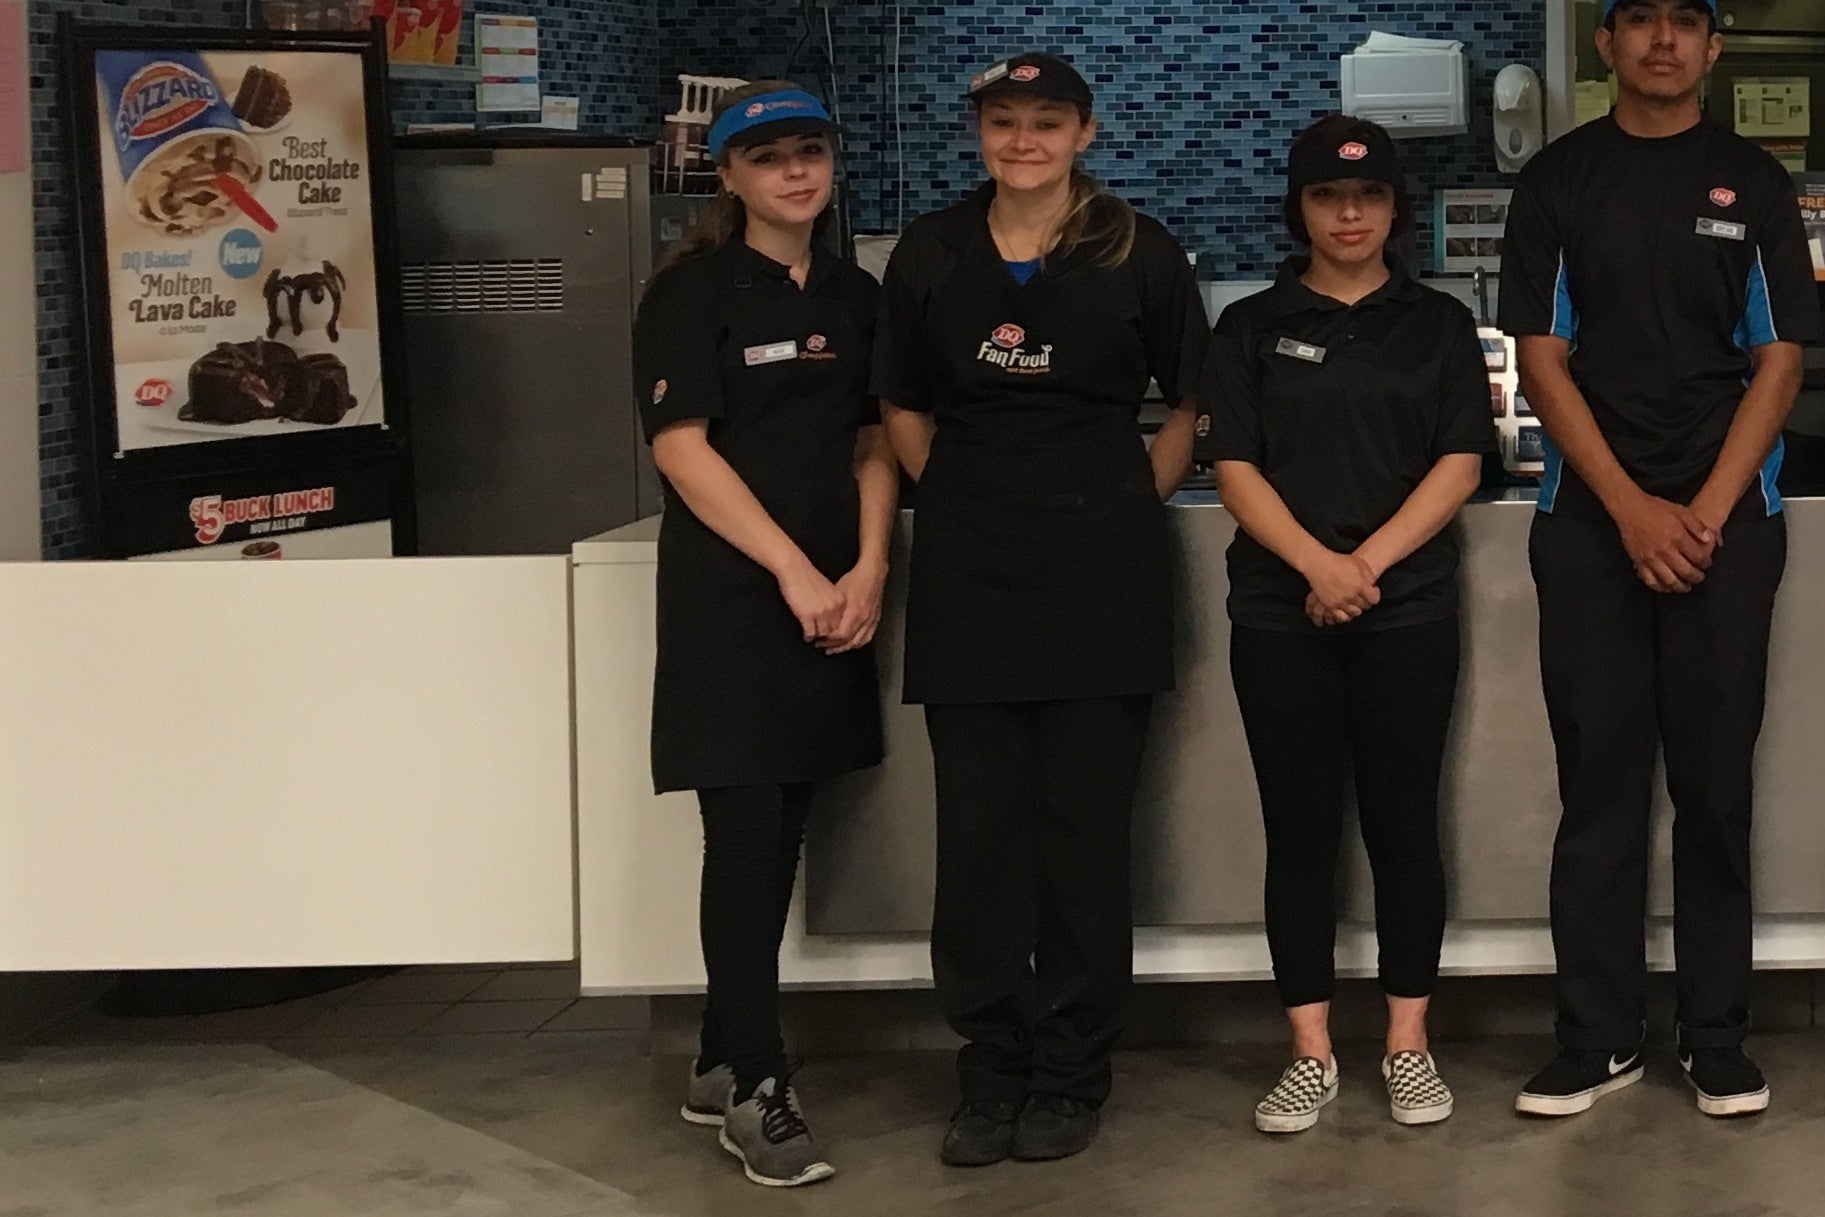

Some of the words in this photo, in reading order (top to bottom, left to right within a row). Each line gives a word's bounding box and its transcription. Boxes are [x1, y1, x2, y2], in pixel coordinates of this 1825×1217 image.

[118, 77, 216, 142] BLIZZARD
[283, 136, 327, 159] Best
[269, 157, 359, 181] Chocolate
[299, 181, 341, 204] Cake
[222, 242, 262, 265] New
[141, 272, 213, 298] Molten
[129, 299, 184, 322] Lava
[188, 295, 237, 319] Cake
[141, 386, 168, 400] DQ
[223, 495, 272, 525] BUCK
[273, 487, 334, 517] LUNCH
